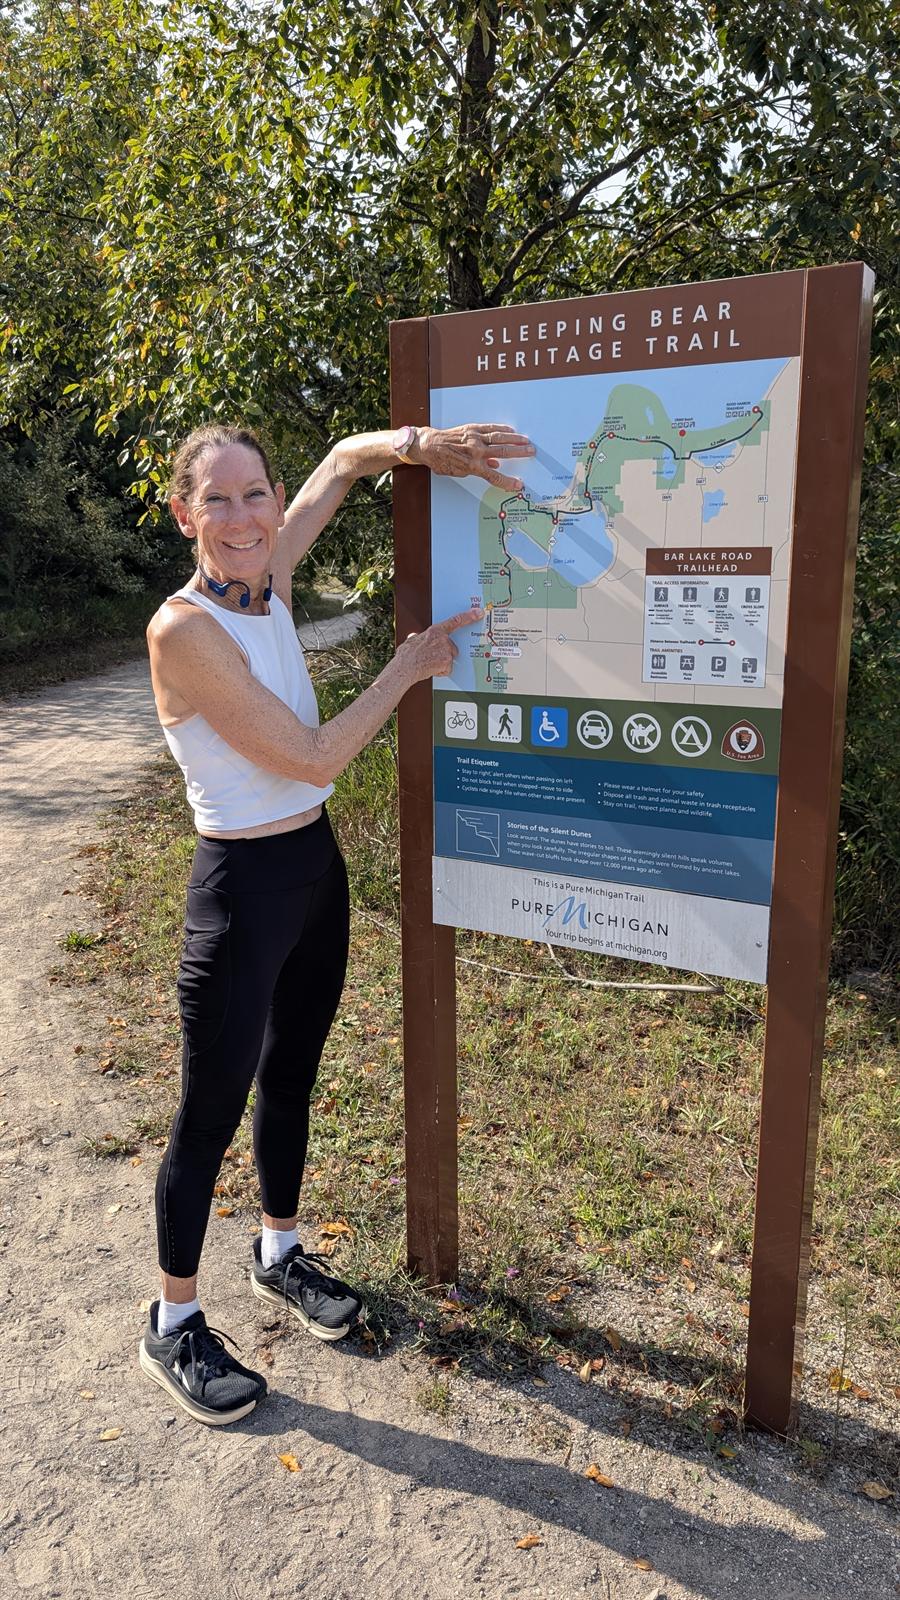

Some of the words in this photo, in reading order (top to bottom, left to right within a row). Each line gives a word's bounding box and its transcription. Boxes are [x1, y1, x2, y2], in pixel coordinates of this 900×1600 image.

[484, 313, 626, 346] SLEEPING
[650, 302, 732, 328] BEAR
[477, 341, 622, 372] HERITAGE
[646, 329, 740, 355] TRAIL
[664, 552, 684, 560] BAR
[471, 759, 499, 767] Etiquette
[603, 791, 624, 799] Dispose
[722, 804, 755, 813] receptacles
[687, 790, 704, 798] safety
[507, 821, 528, 831] Stories
[550, 826, 569, 835] Silent
[570, 830, 592, 838] Dunes
[578, 850, 600, 859] irregular
[671, 862, 692, 870] formed
[633, 849, 660, 858] seemingly
[690, 856, 707, 864] speak
[533, 878, 549, 887] This
[565, 883, 584, 893] Pure
[585, 886, 623, 900] Michigan
[625, 892, 644, 903] Trail
[512, 898, 553, 916] PURE
[542, 896, 669, 937] MICHIGAN
[545, 928, 562, 939] Your
[563, 931, 576, 942] trip
[578, 934, 604, 947] begins
[606, 940, 614, 948] at
[615, 942, 668, 960] michigan.org
